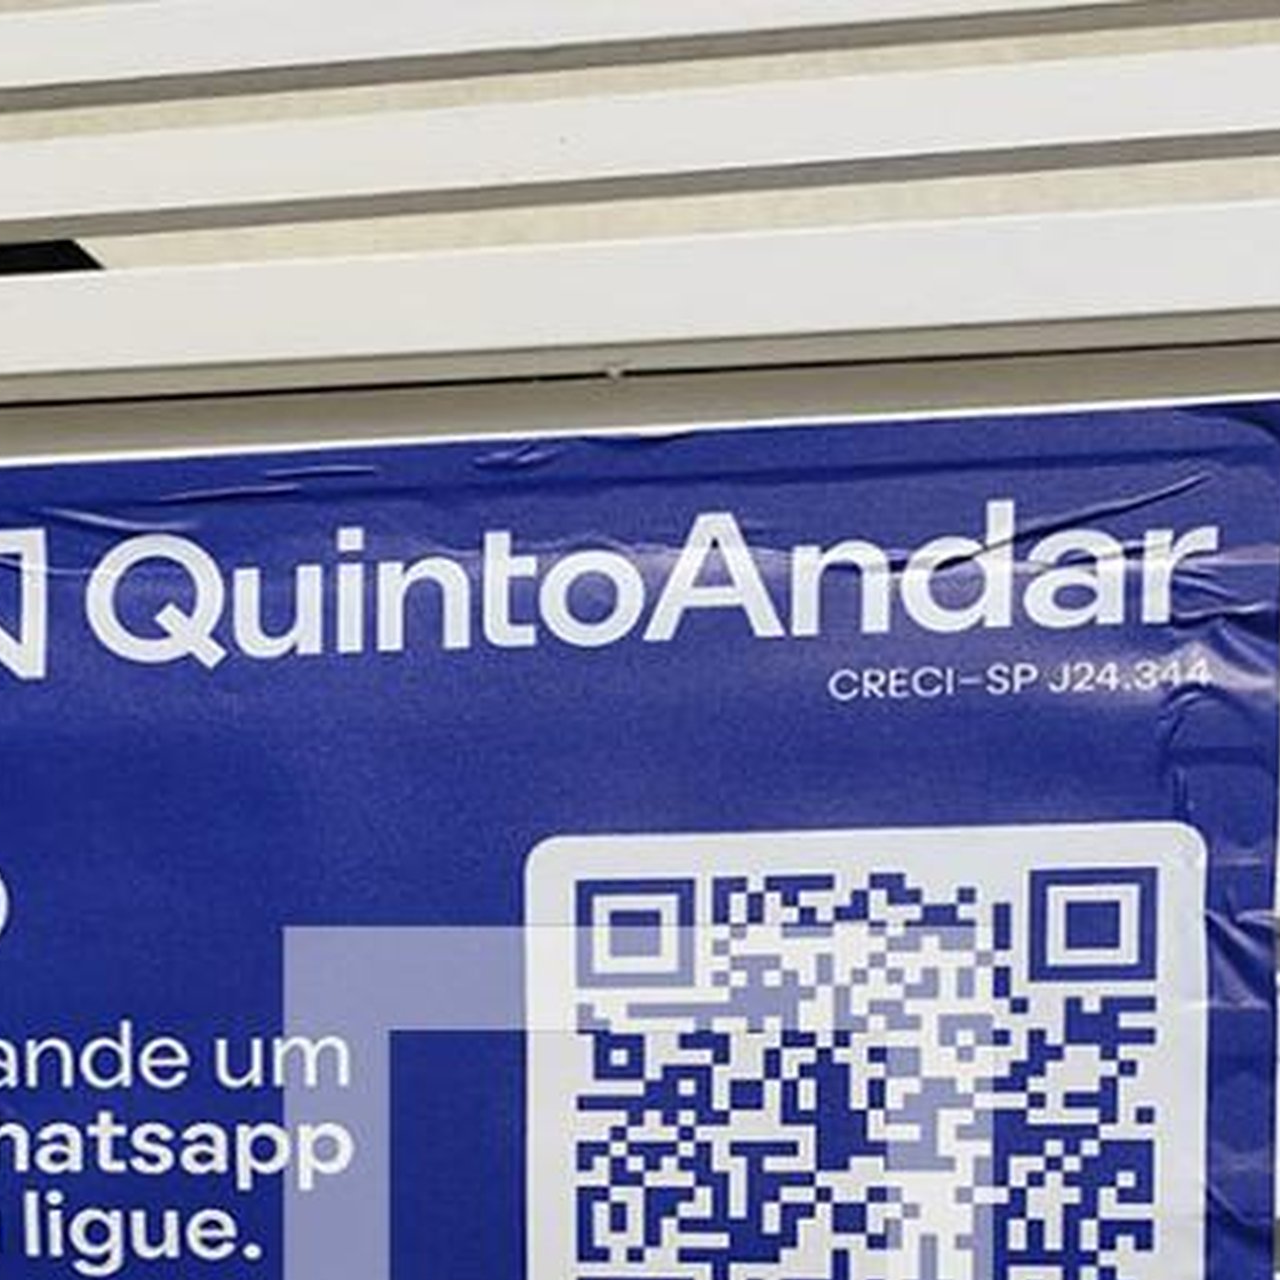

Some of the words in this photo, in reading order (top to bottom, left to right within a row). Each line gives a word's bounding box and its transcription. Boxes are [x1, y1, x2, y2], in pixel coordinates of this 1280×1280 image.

[85, 499, 1220, 670] QuintoAndar
[827, 661, 1038, 701] CRECI-SP
[1048, 657, 1212, 693] J24.344
[214, 1034, 351, 1088] um
[23, 1190, 262, 1277] ligue.
